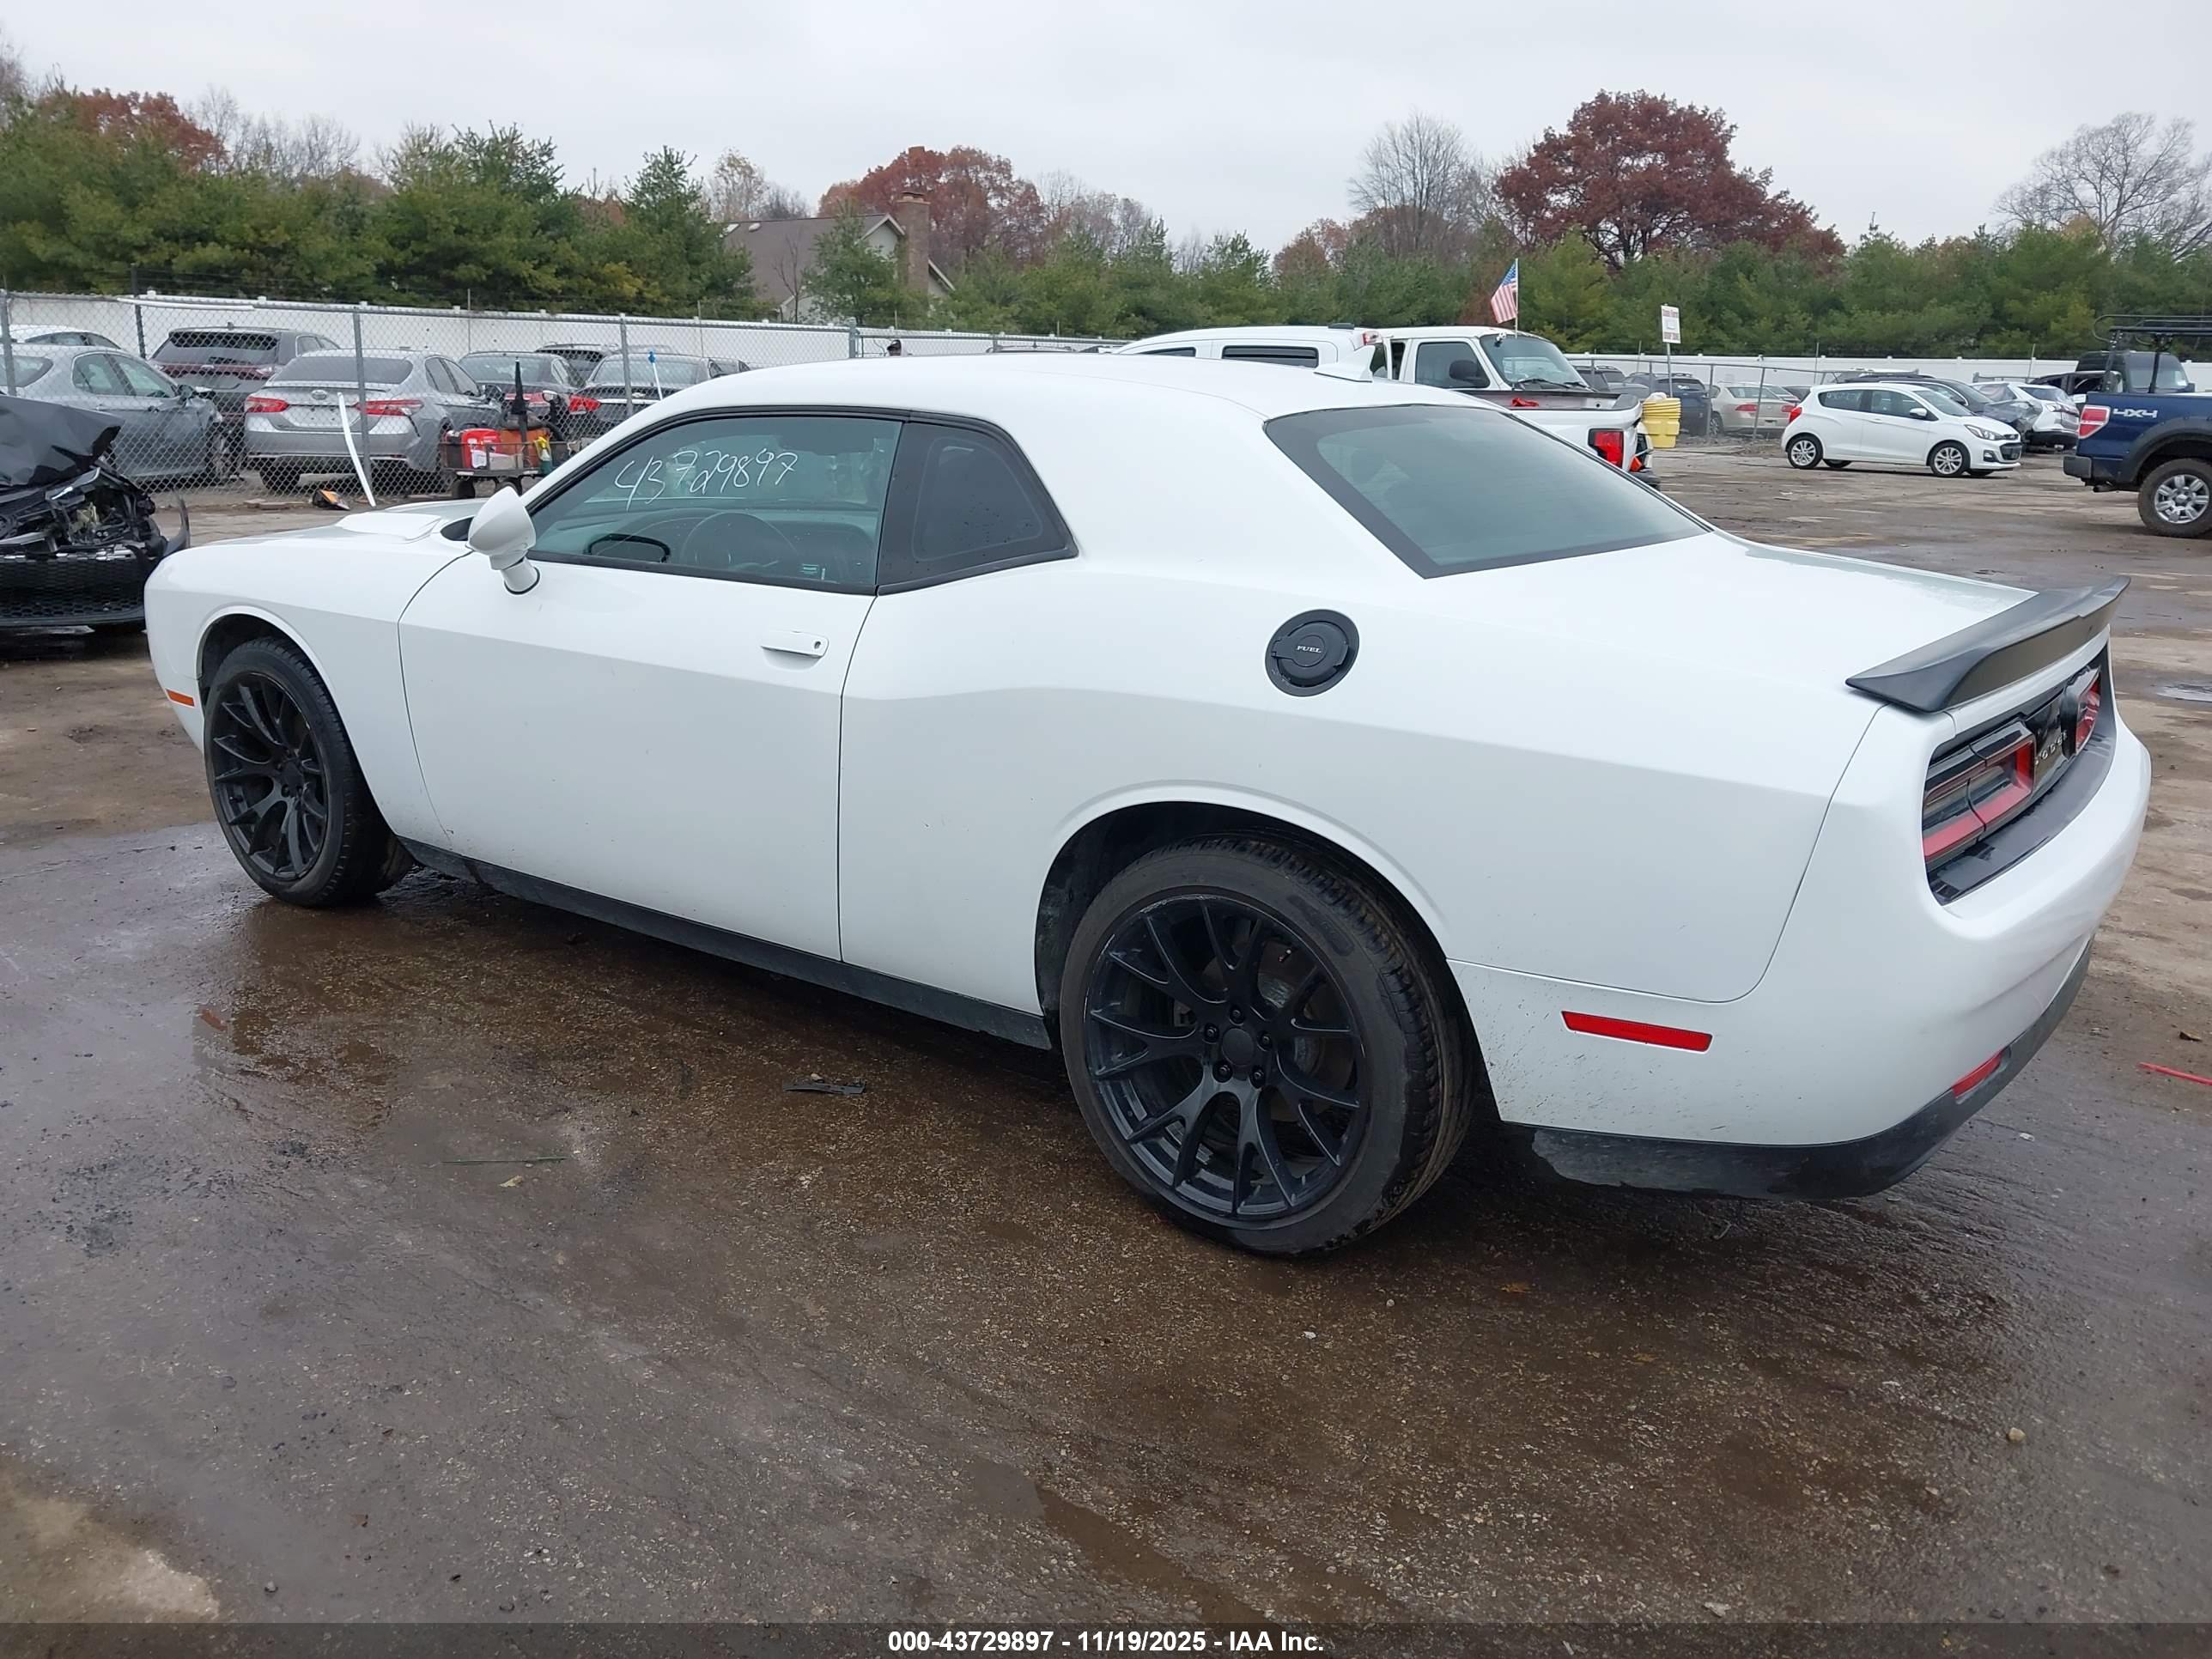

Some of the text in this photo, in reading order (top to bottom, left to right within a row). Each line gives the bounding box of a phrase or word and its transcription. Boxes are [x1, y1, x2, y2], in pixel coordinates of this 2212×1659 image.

[2112, 408, 2159, 418] 4X4
[614, 448, 798, 511] 43729897
[1296, 645, 1322, 653] FUEL
